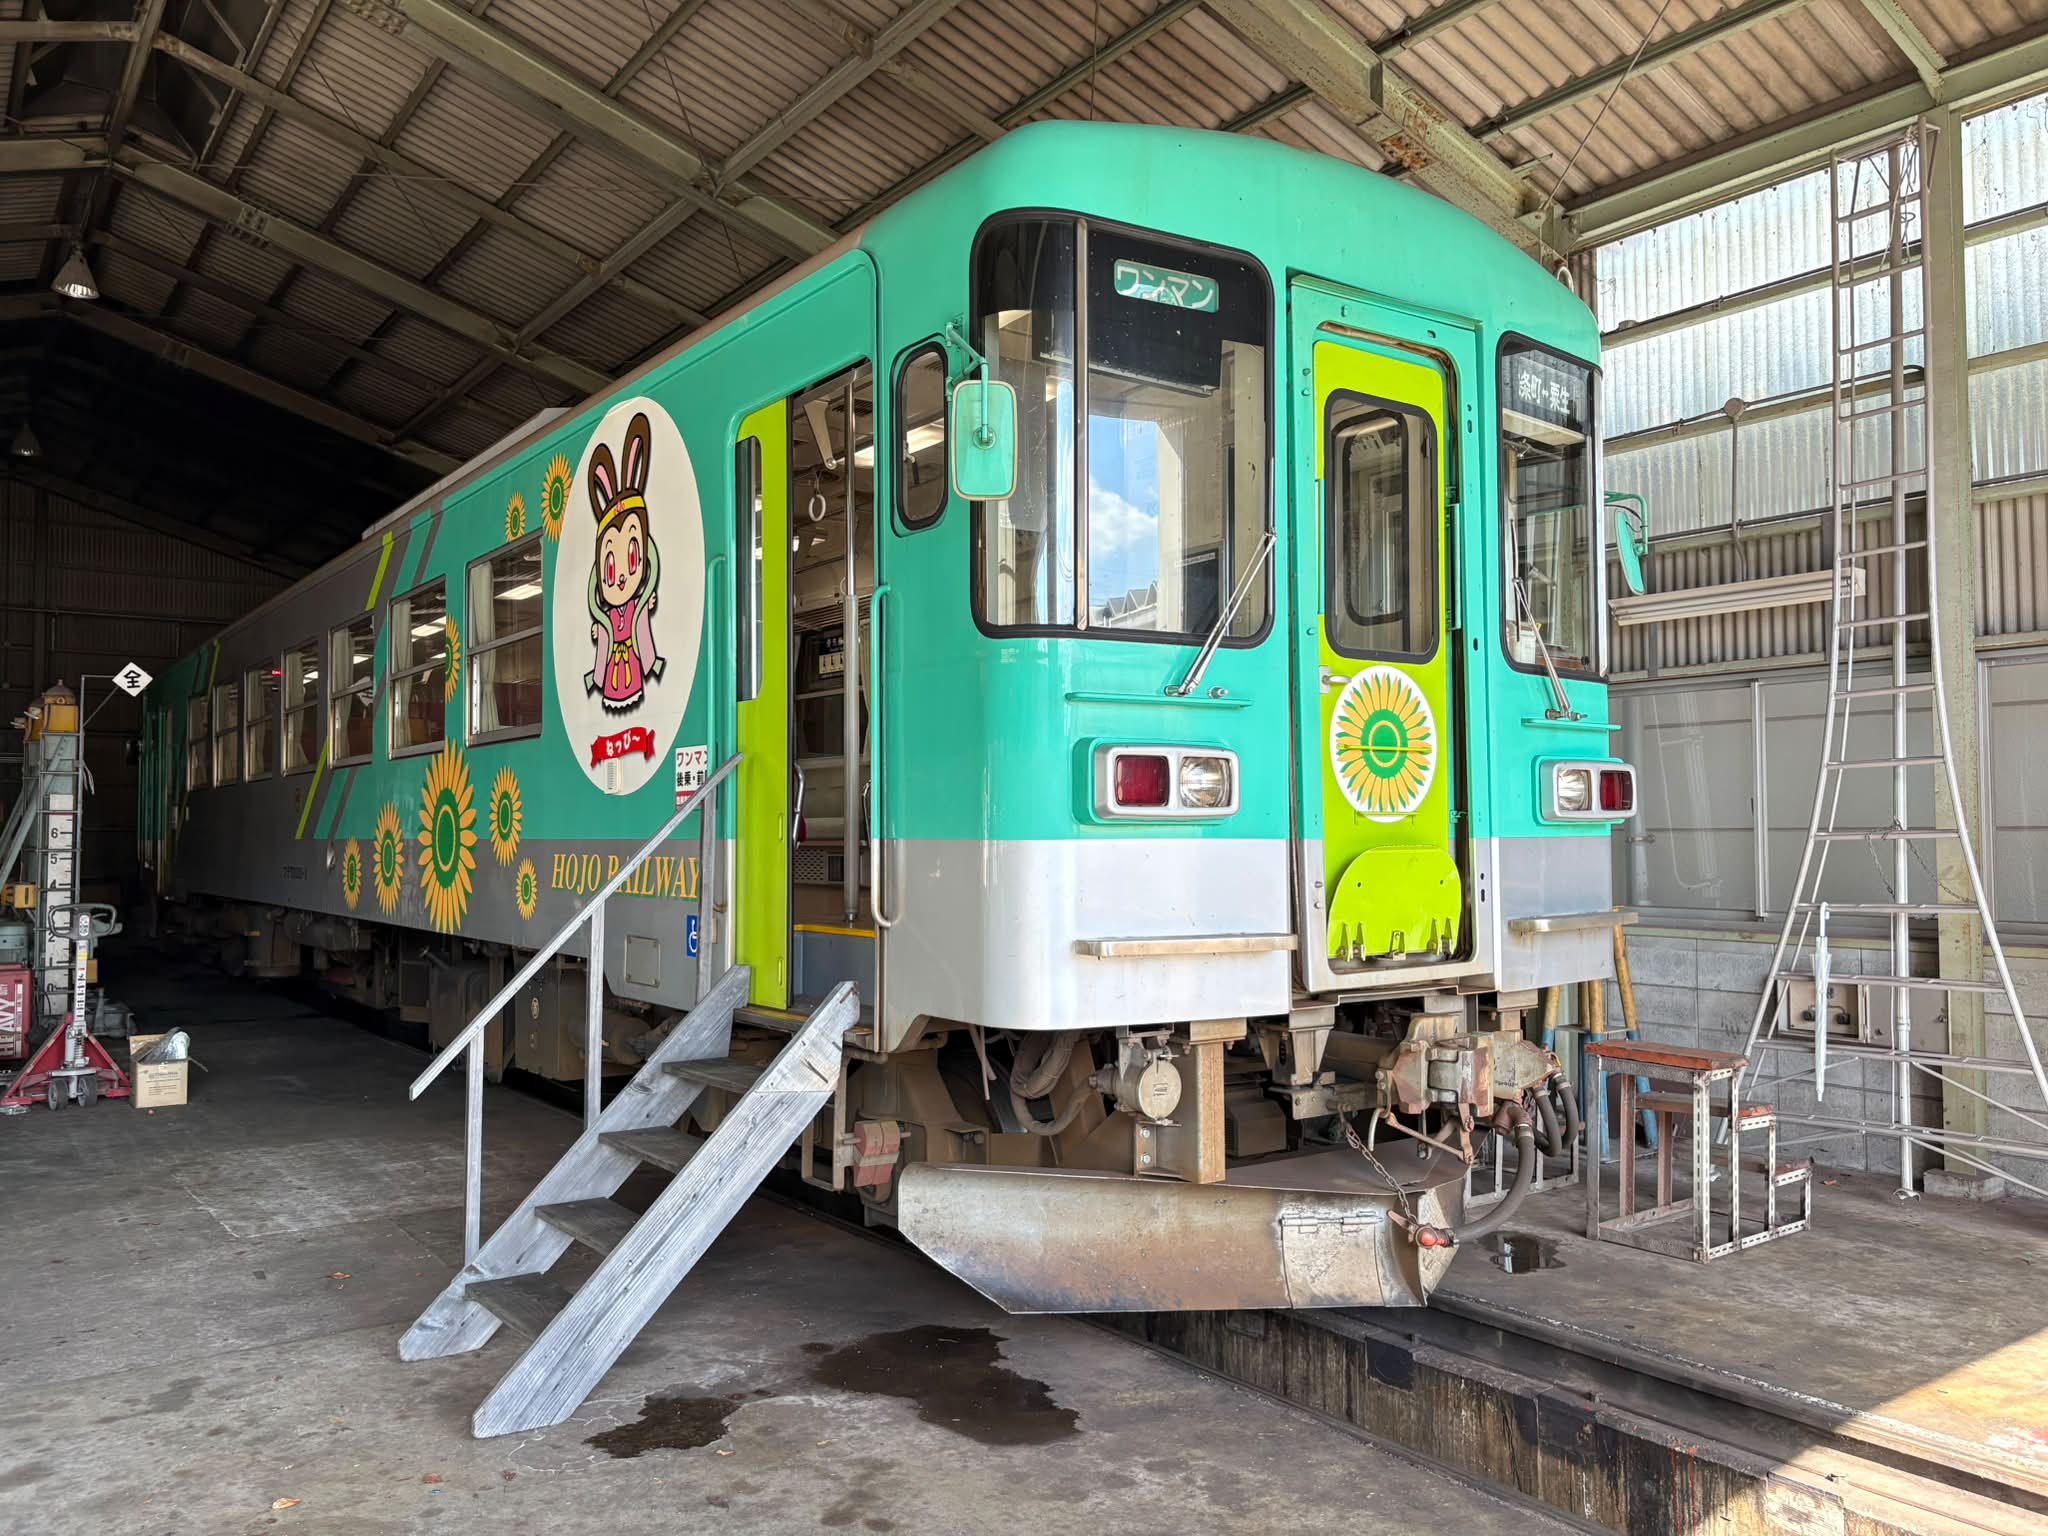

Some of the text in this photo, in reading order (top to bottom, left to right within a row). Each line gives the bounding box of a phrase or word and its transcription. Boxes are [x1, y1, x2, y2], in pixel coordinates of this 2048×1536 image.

[1117, 265, 1214, 310] ワンマン
[677, 769, 708, 787] 後乗・前
[50, 827, 58, 839] 6
[50, 853, 58, 865] 5
[551, 853, 602, 895] HOJO
